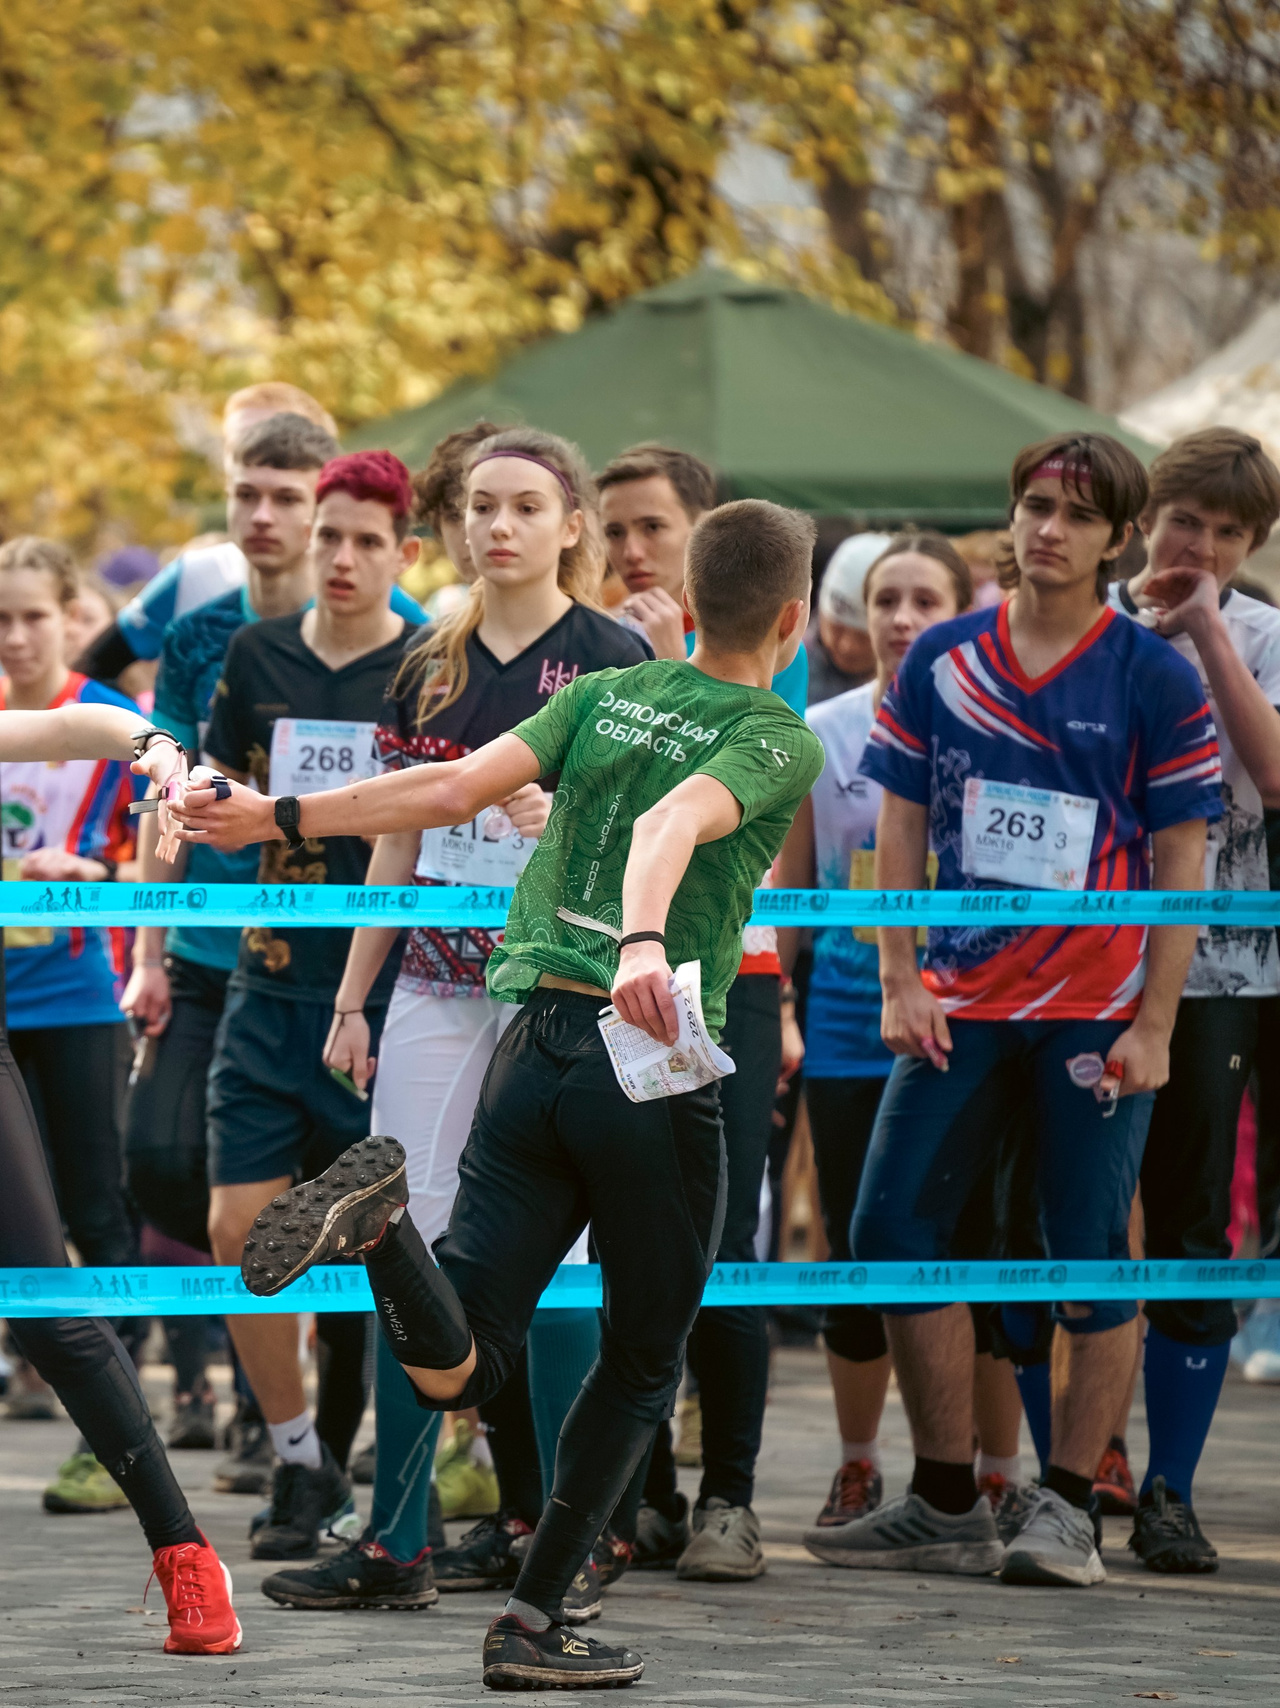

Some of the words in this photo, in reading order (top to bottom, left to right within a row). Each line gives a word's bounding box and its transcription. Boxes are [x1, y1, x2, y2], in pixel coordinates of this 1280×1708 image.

[598, 691, 720, 746] ОРЛОВСКАЯ
[299, 745, 354, 772] 268
[595, 718, 687, 763] ОБЛАСТЬ
[597, 793, 624, 855] VICTORY
[986, 807, 1045, 841] 263
[1054, 832, 1067, 850] 3
[582, 860, 600, 902] CODE
[684, 996, 700, 1039] 229.2
